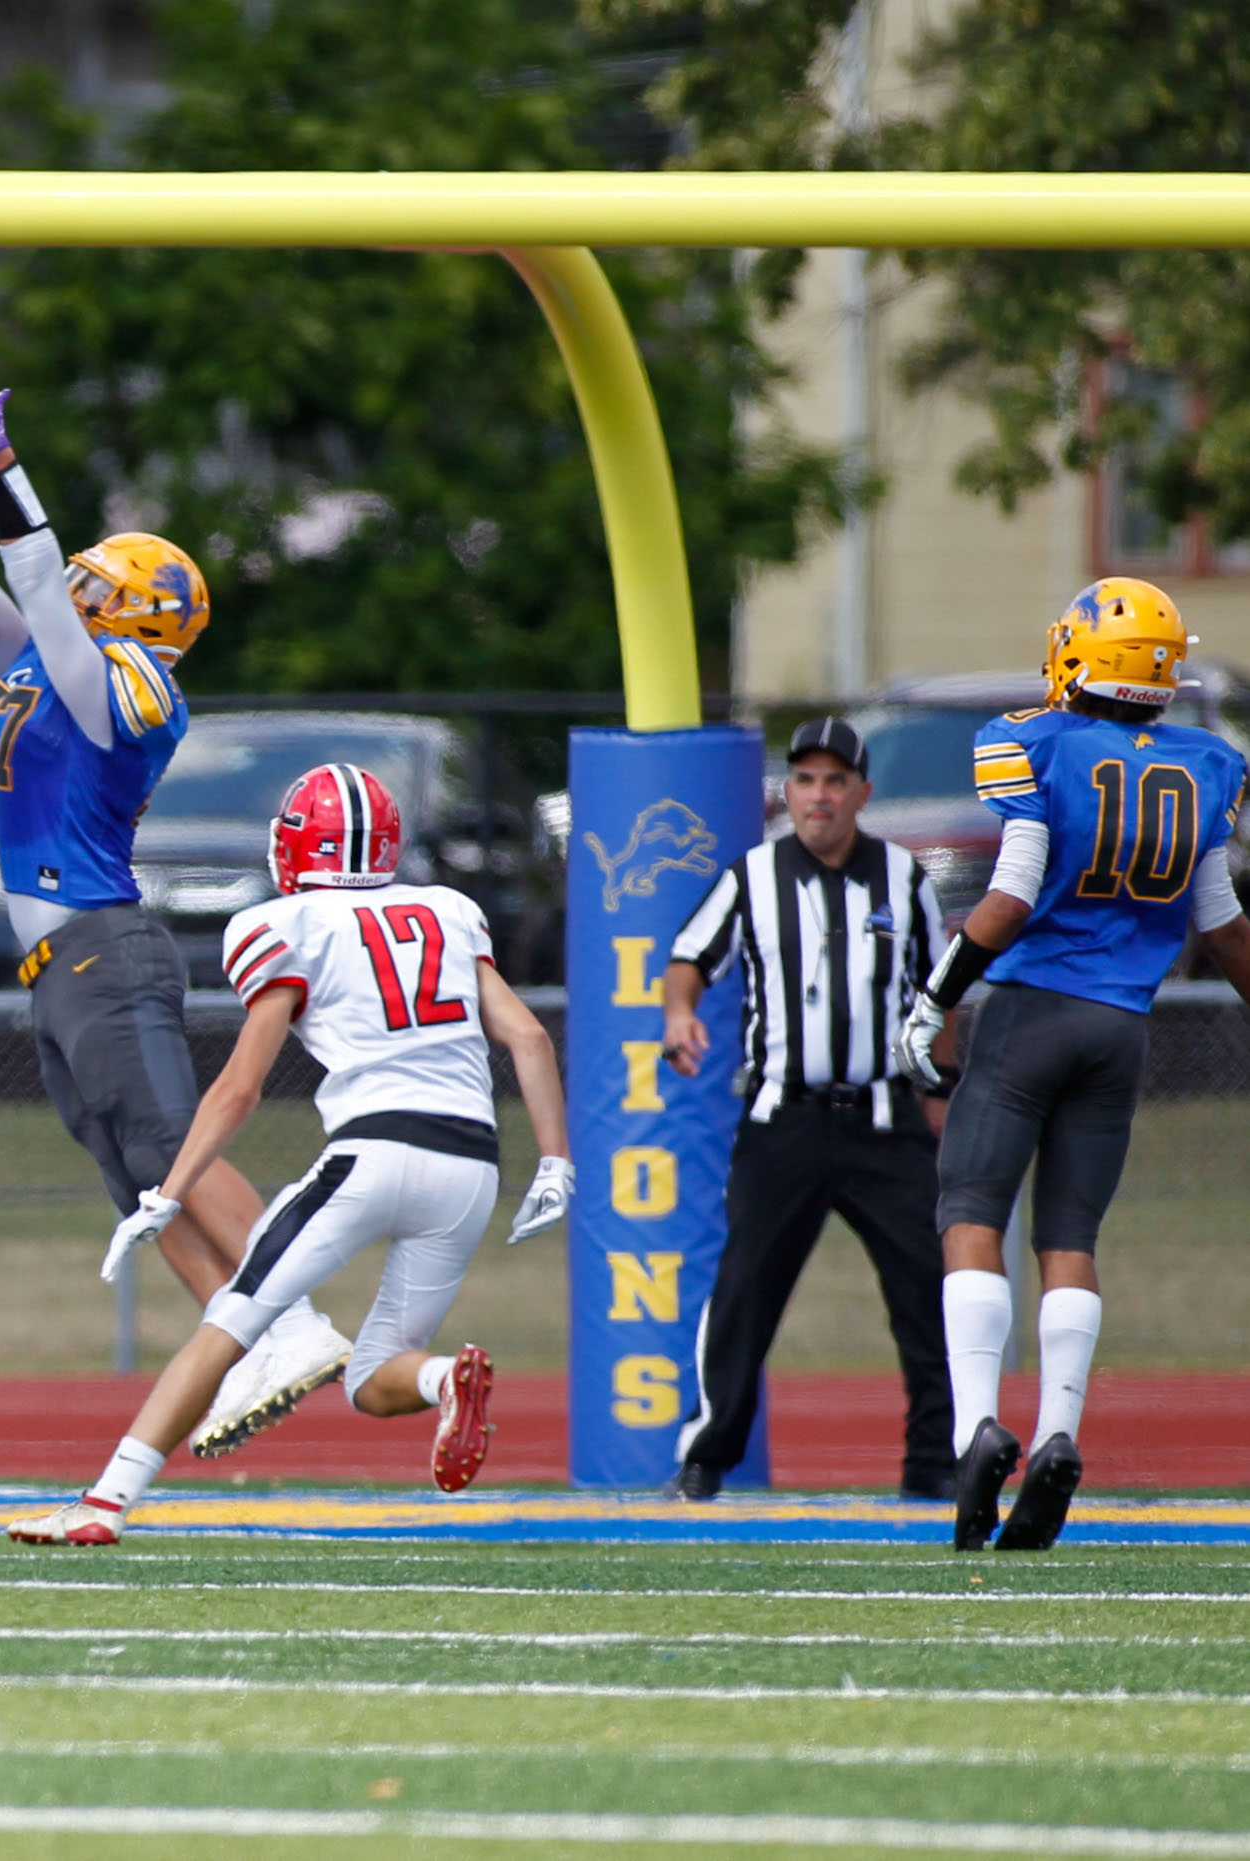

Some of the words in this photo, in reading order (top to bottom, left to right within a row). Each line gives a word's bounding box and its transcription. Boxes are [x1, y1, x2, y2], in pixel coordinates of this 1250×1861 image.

[1116, 687, 1171, 703] Riddell
[1077, 759, 1198, 903] 10
[354, 904, 467, 1031] 12
[607, 937, 683, 1430] LIONS
